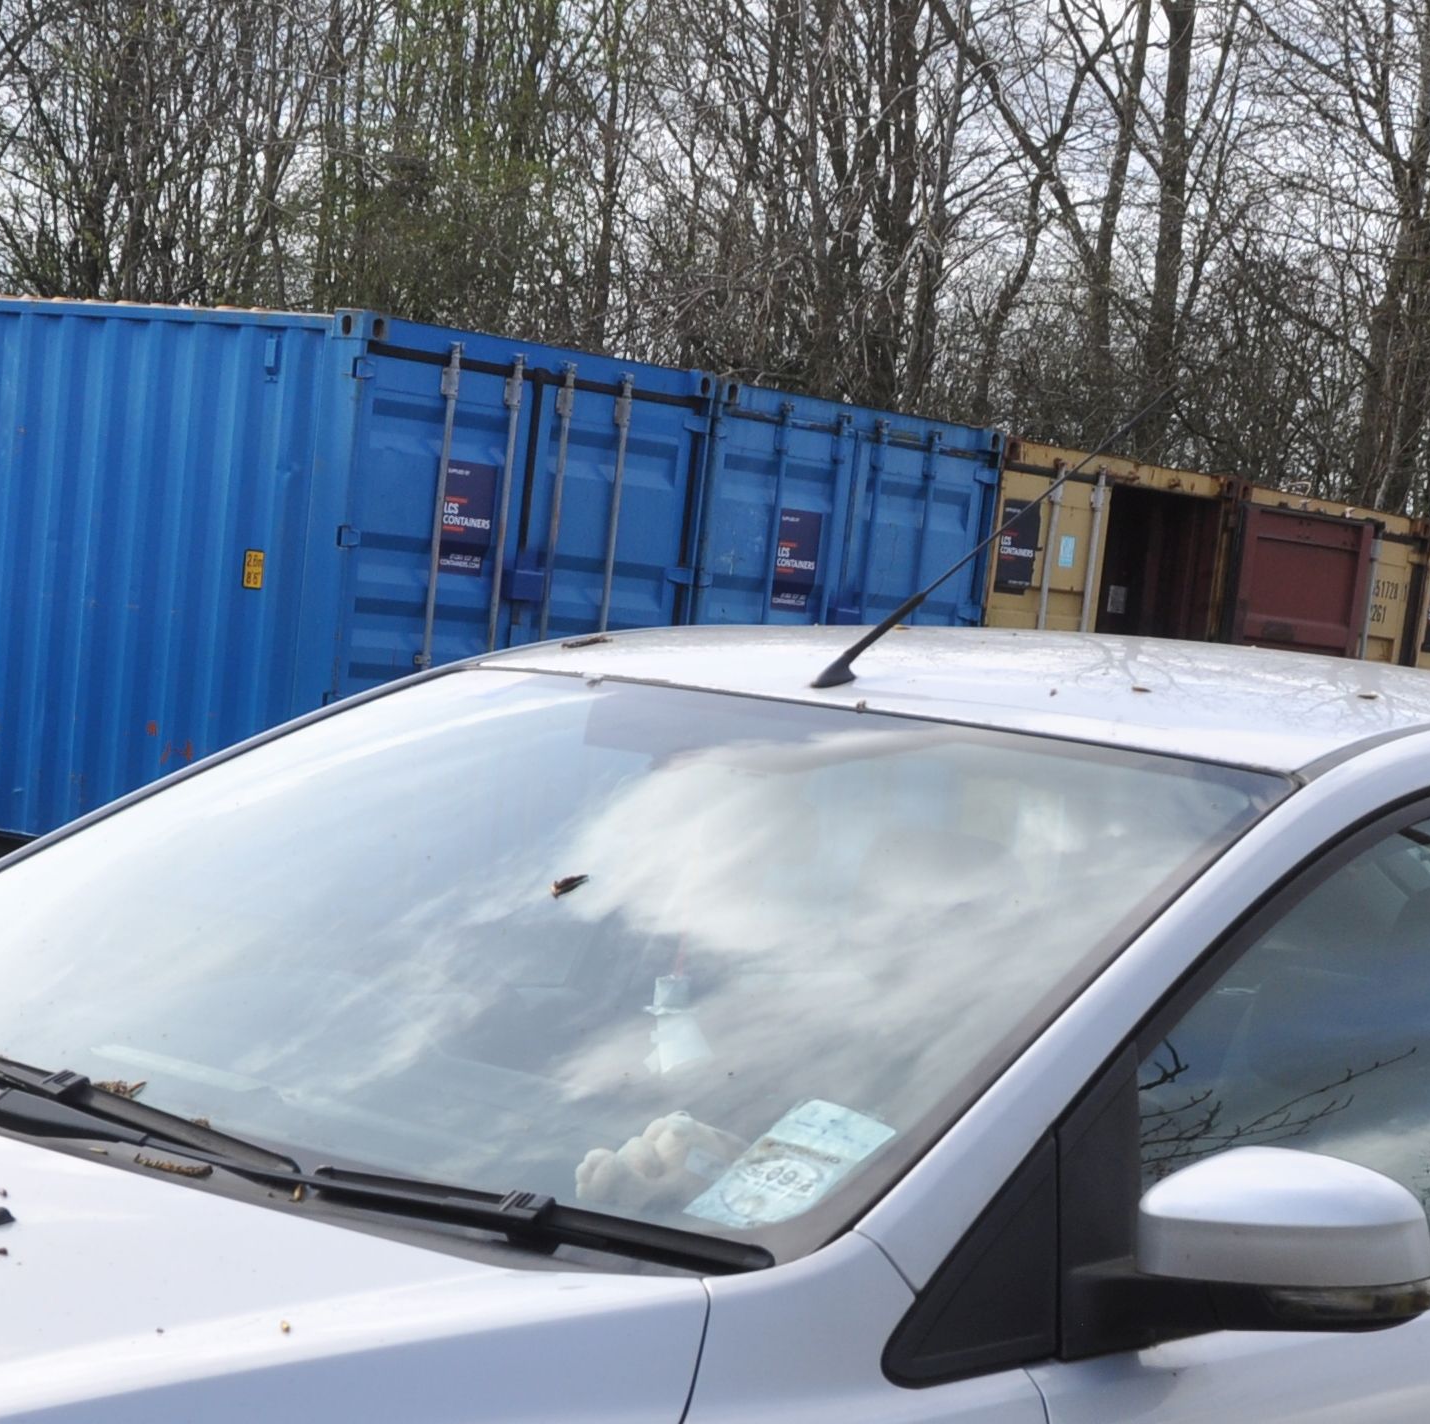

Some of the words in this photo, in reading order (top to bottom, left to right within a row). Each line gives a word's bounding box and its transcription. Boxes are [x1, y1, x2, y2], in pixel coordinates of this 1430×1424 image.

[444, 502, 459, 514] LCS
[443, 515, 490, 529] CONTAINERS
[1001, 535, 1012, 545] LCS
[778, 546, 790, 557] LCS
[1000, 546, 1033, 558] CONTAINERS
[777, 558, 815, 570] CONTAINERS
